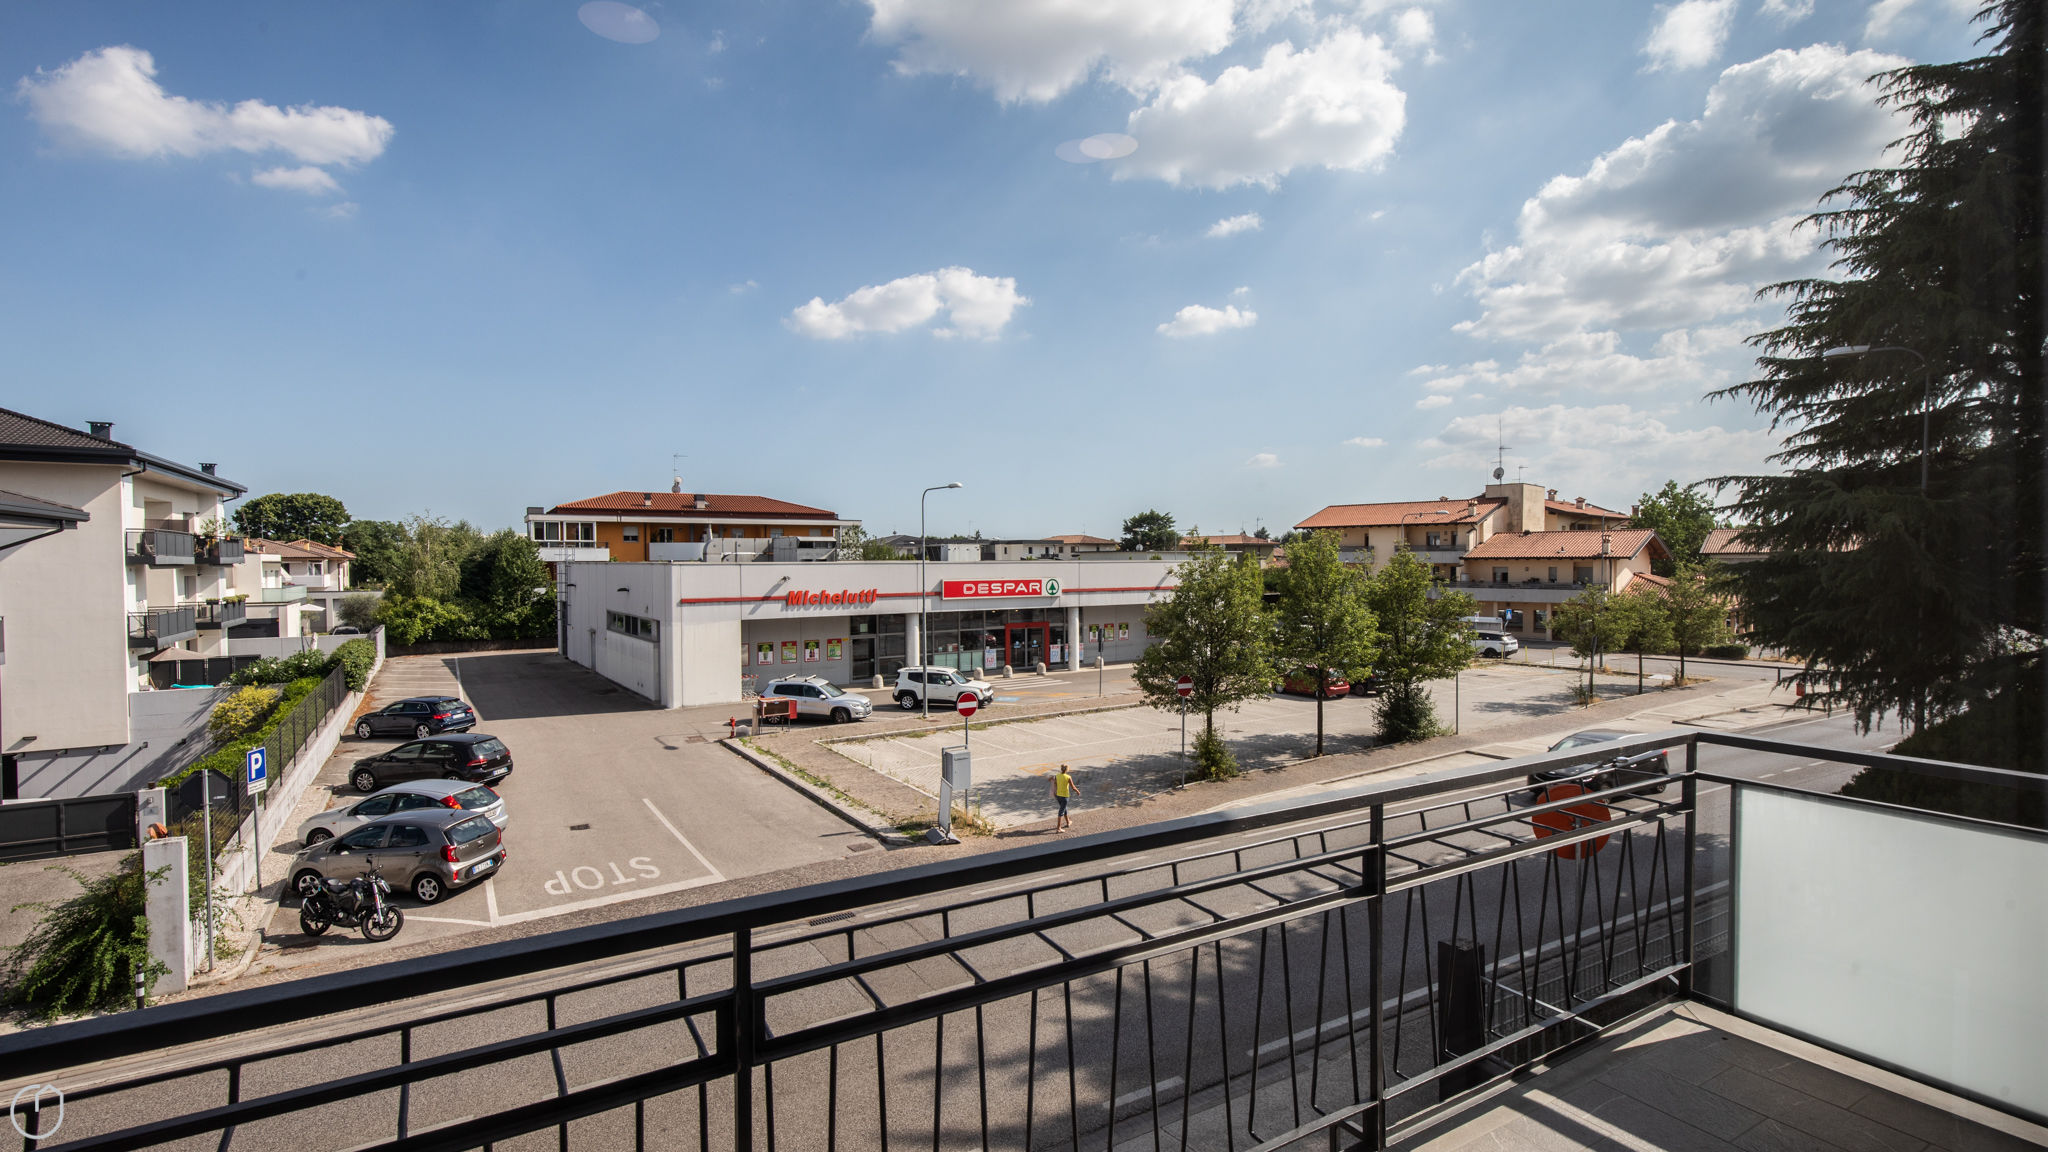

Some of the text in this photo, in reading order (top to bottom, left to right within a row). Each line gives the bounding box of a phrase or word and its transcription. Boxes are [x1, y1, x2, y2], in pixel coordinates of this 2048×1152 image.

[963, 583, 1041, 595] DESPAR
[251, 753, 262, 779] P
[544, 857, 660, 895] STOP
